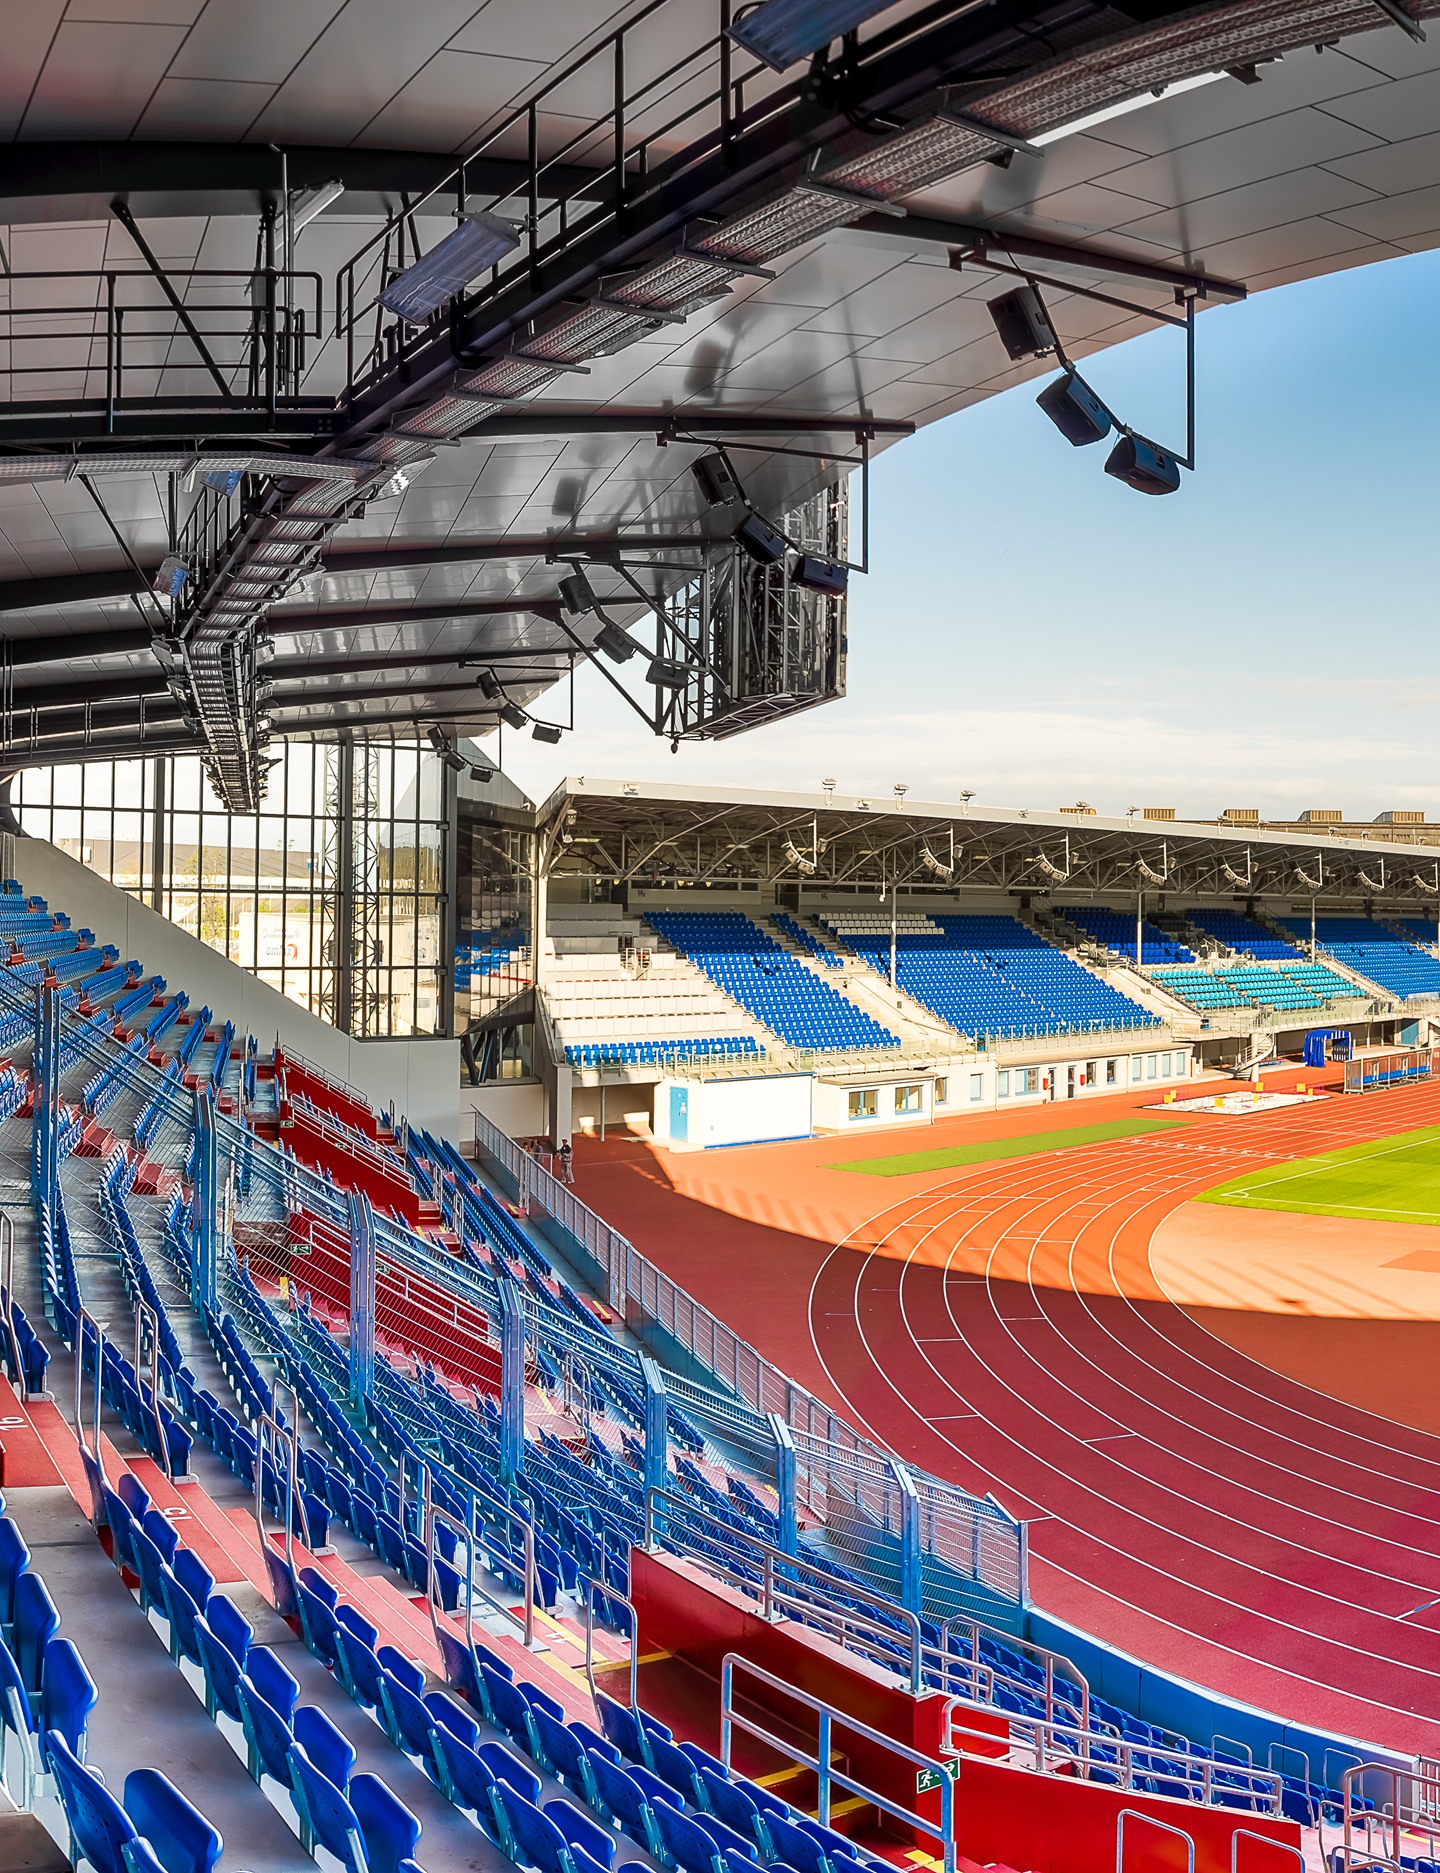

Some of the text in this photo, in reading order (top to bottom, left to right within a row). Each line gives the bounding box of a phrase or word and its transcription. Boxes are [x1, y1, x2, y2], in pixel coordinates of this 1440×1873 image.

[0, 1416, 29, 1431] 16
[163, 1507, 192, 1524] 15
[544, 1631, 574, 1644] 11
